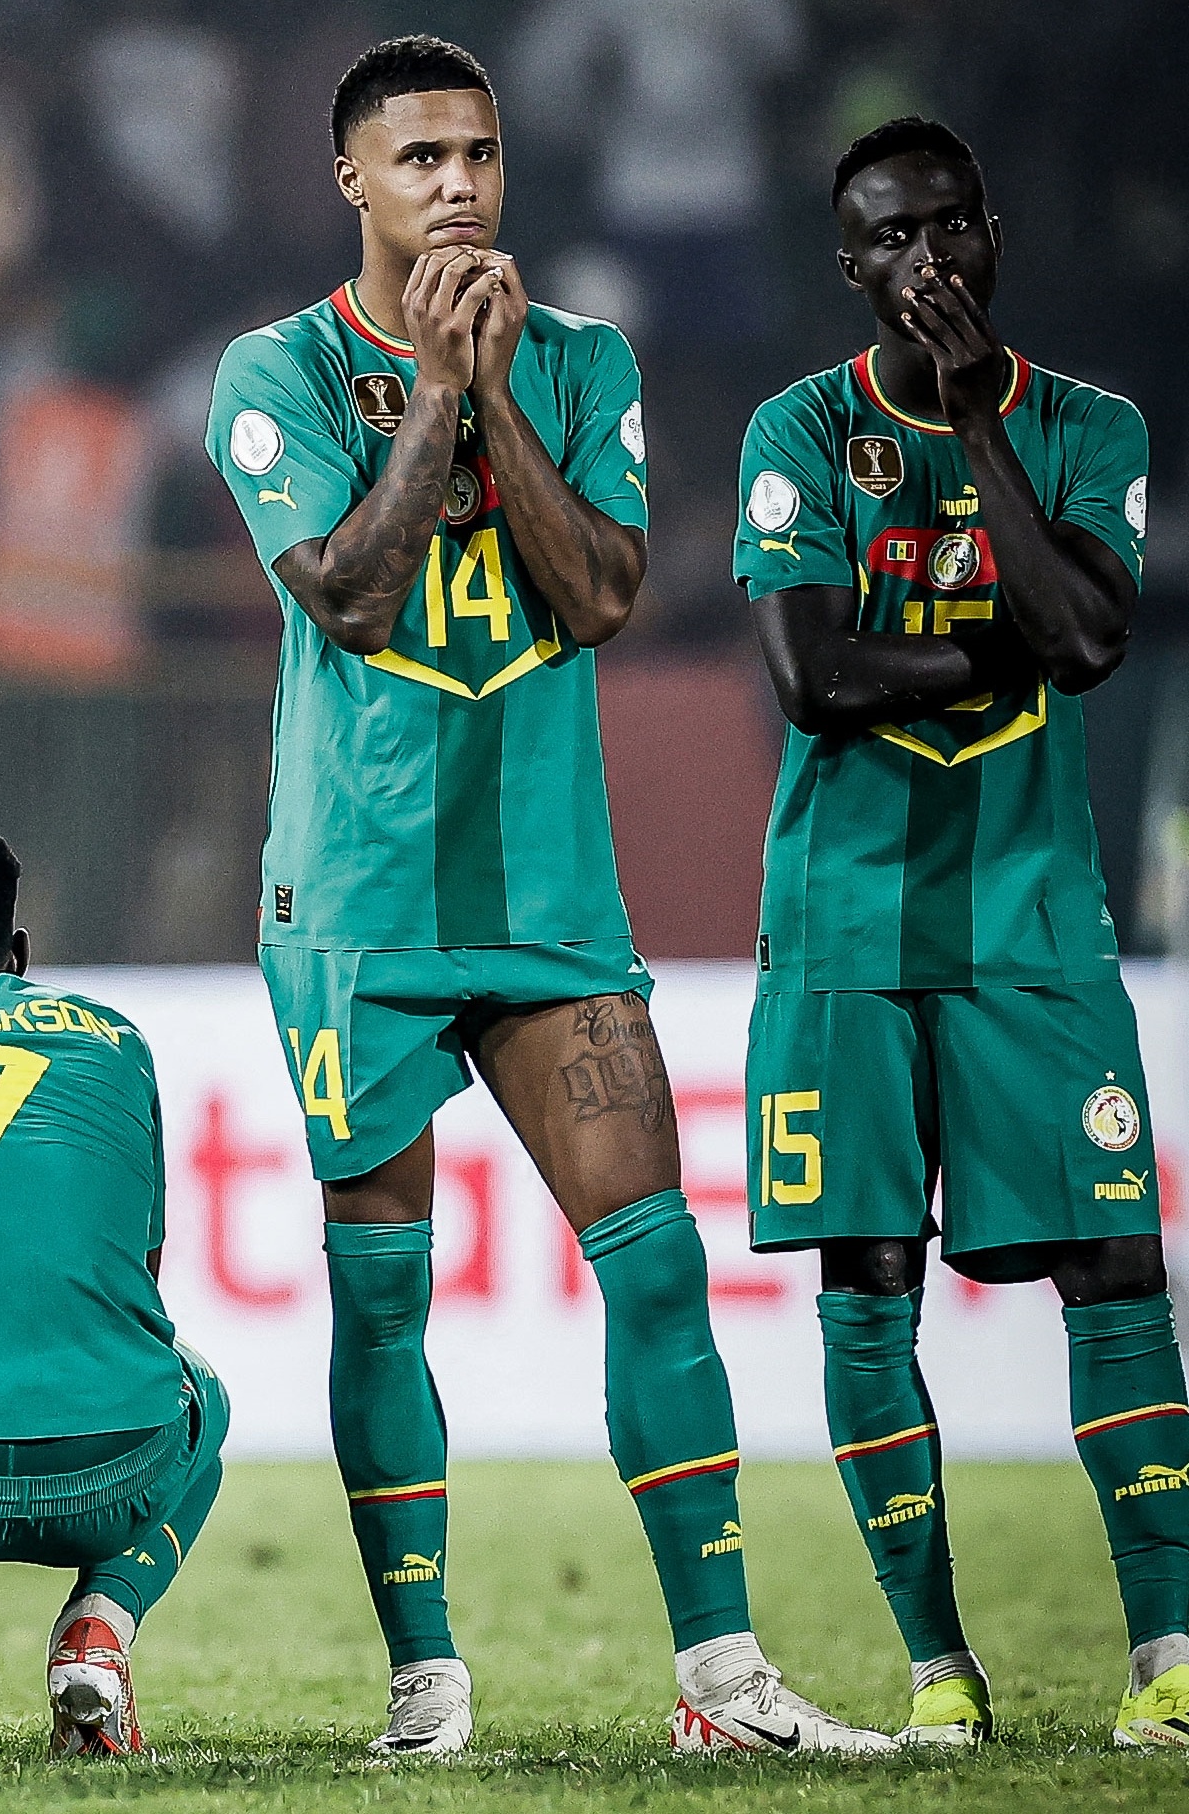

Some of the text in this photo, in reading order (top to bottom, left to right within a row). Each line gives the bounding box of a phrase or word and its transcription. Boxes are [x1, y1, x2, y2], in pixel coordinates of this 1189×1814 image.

[424, 527, 512, 647] 14
[760, 1089, 823, 1207] 15
[1094, 1182, 1141, 1200] PUMA
[1114, 1476, 1182, 1502] PUMA
[867, 1502, 928, 1531] PUMA
[383, 1567, 434, 1585] PUMA
